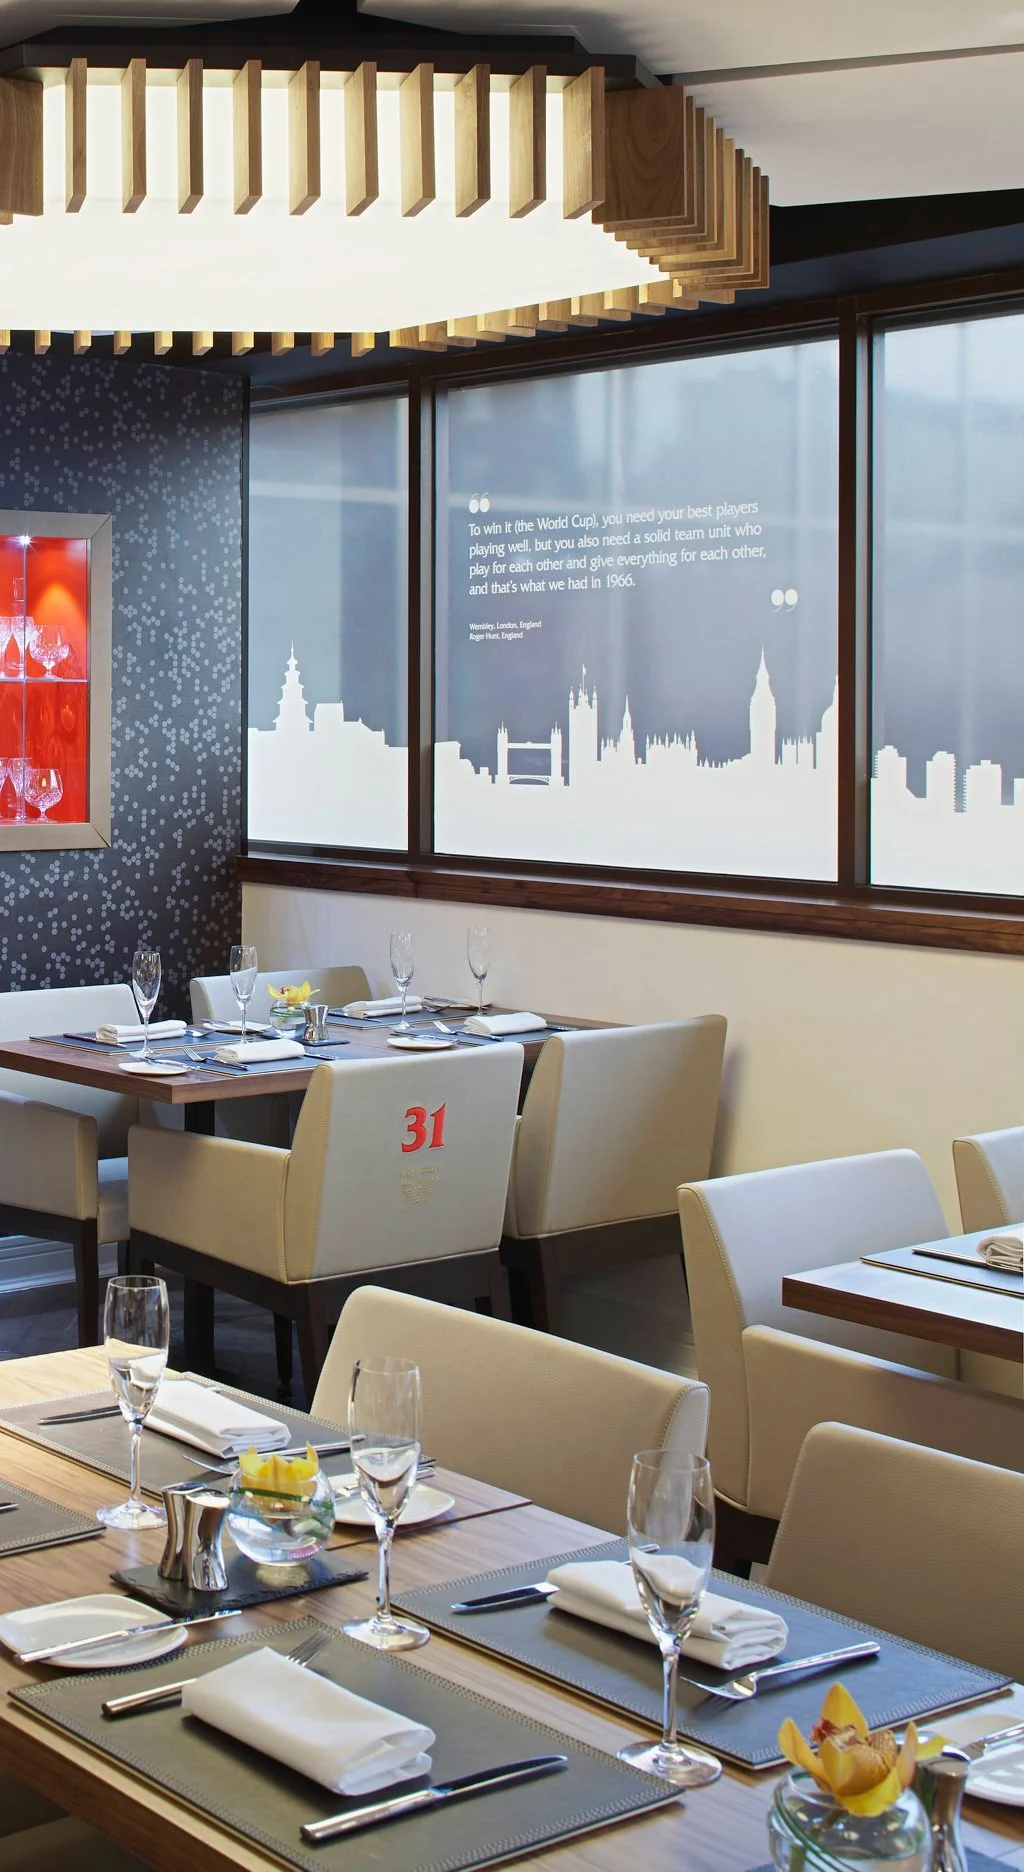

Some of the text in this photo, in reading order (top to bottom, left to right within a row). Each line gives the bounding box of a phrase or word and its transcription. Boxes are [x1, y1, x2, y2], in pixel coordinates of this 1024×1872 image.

[469, 502, 758, 536] To win it (the World Cup), you need your best players
[470, 523, 761, 559] playing well, but you also need a solid team unit who
[470, 545, 766, 579] play for each other and give everything for each other,
[470, 582, 488, 595] and
[520, 580, 545, 592] what
[548, 580, 564, 590] we
[568, 576, 587, 589] had
[591, 576, 601, 588] in
[607, 574, 635, 587] 1966.
[469, 623, 495, 631] Wembley,
[520, 621, 541, 630] England
[470, 633, 484, 641] Roger
[502, 632, 523, 640] England
[401, 1102, 447, 1152] 31
